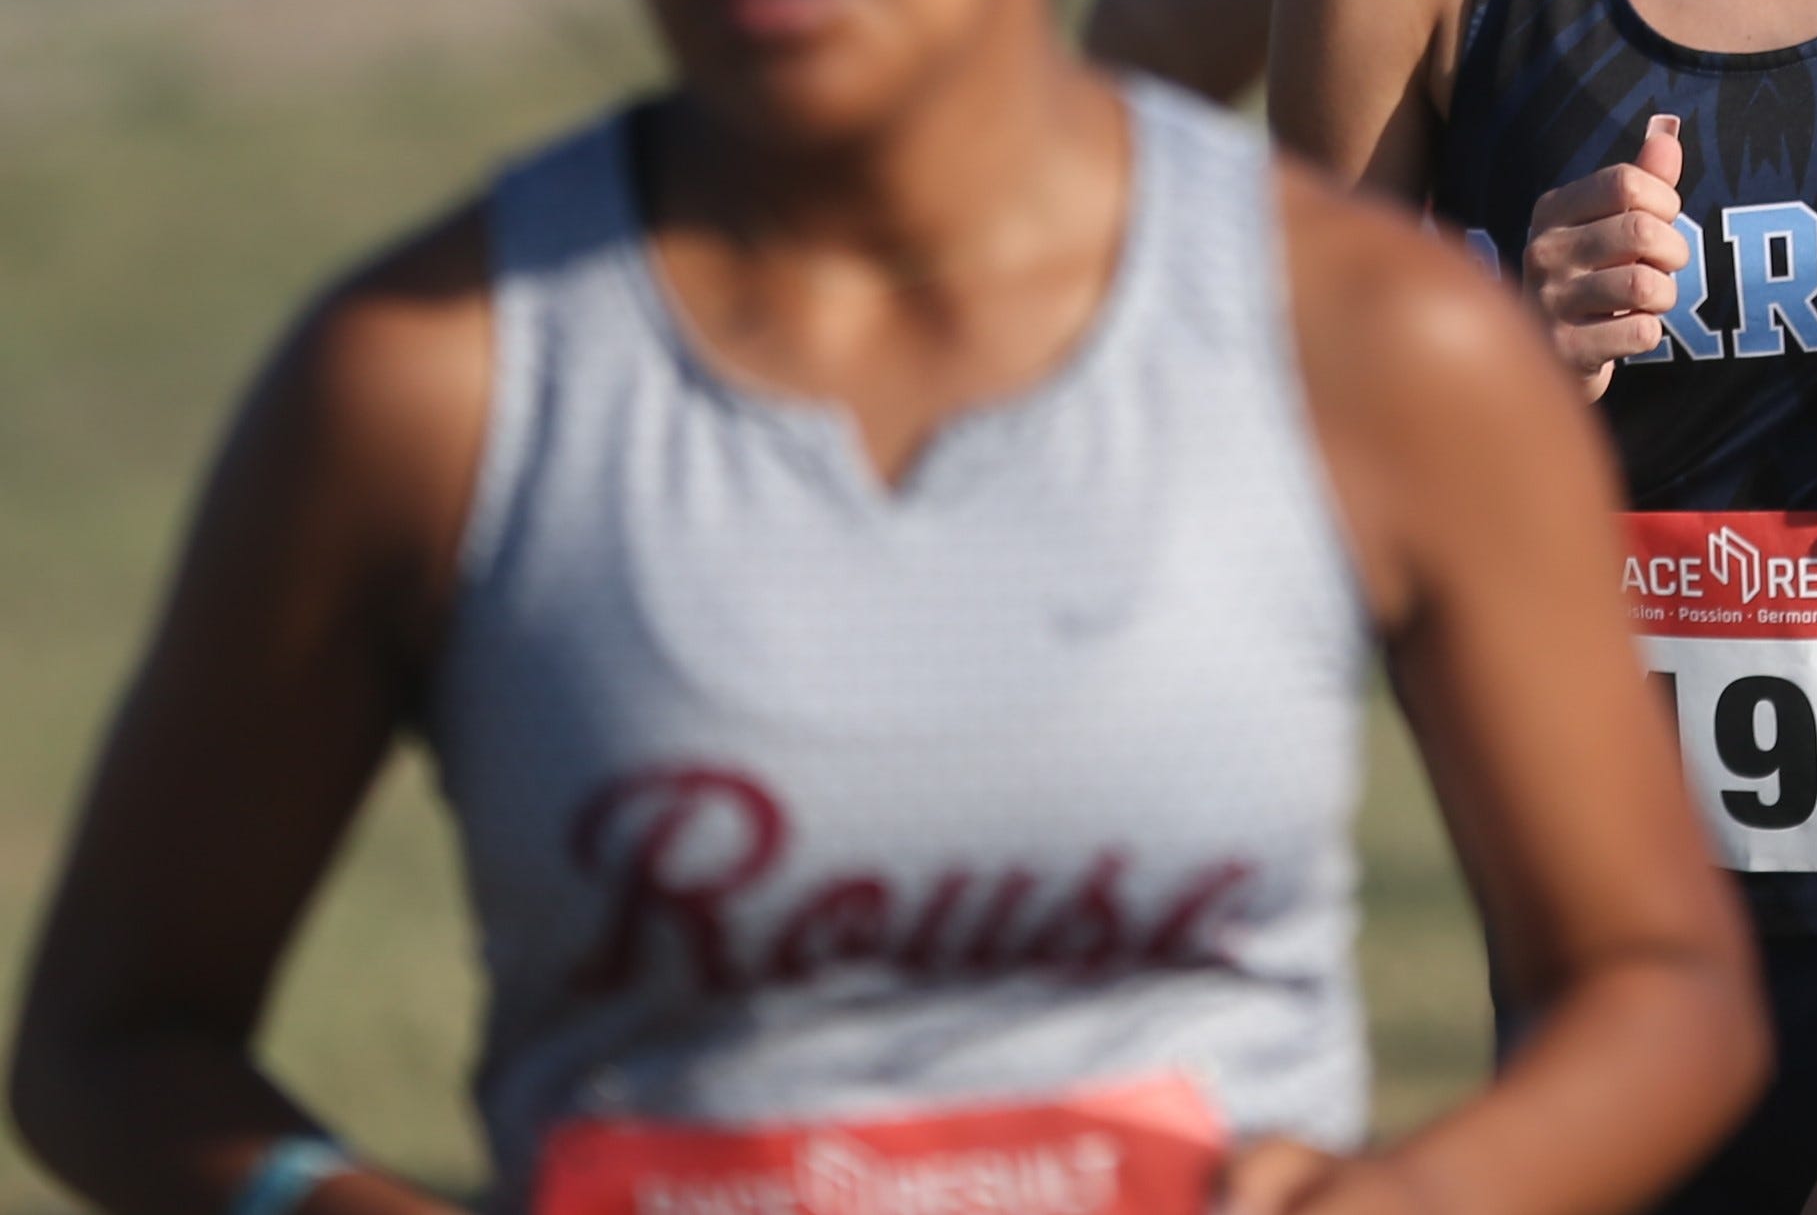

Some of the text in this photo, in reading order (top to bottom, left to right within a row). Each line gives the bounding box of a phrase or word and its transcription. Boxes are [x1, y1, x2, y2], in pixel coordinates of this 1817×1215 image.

[1620, 556, 1704, 597] ACE
[1678, 606, 1743, 623] Passion
[565, 756, 1275, 998] Rouse
